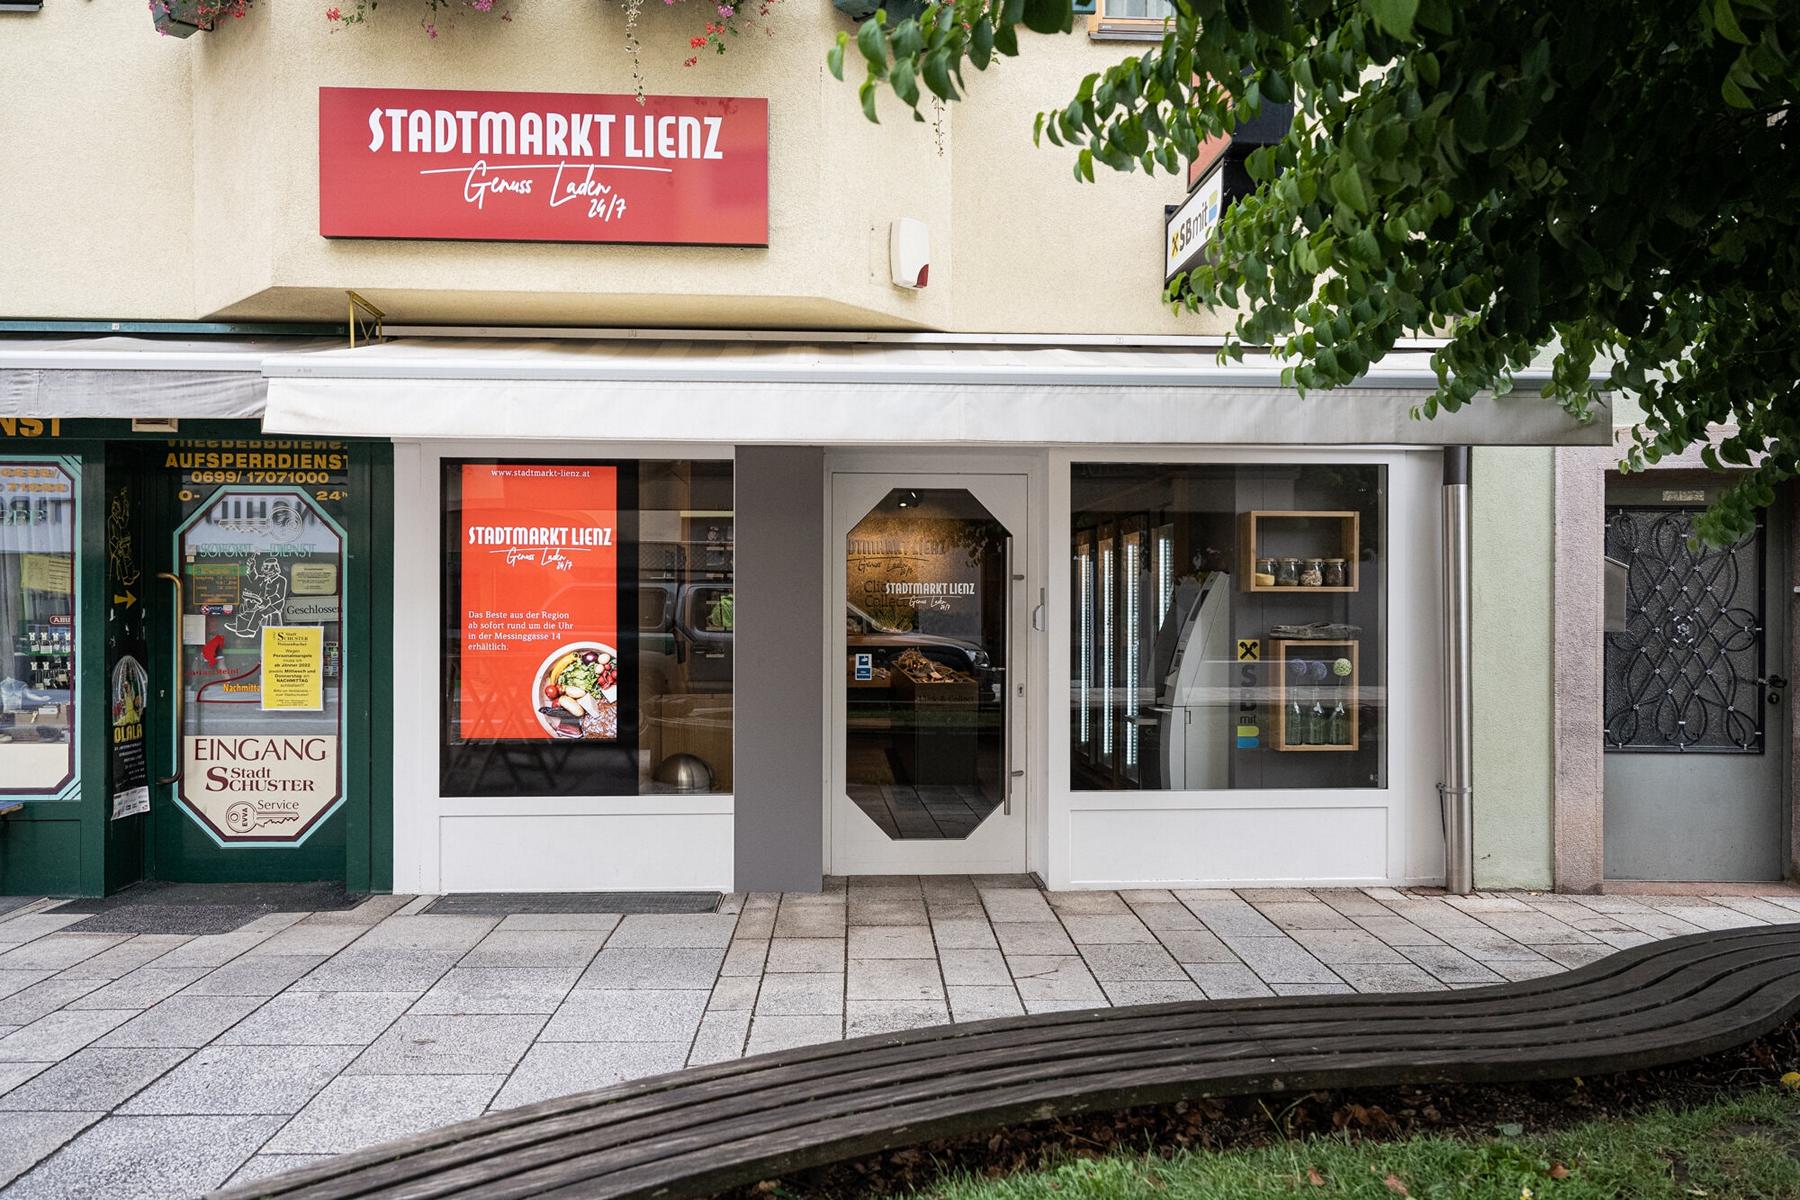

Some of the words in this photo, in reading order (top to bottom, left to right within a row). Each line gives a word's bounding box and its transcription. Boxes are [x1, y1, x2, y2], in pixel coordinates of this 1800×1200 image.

[368, 107, 616, 157] STADTMARKT
[625, 114, 723, 160] LIENZ
[464, 159, 533, 210] Genuss
[549, 160, 612, 207] Laden
[588, 198, 627, 222] 24/7
[191, 471, 241, 484] 0699/
[247, 471, 329, 484] 17071000
[491, 468, 590, 478] www.stadtmarkt-lienz.at
[468, 526, 569, 545] STADTMARKT
[571, 527, 612, 546] LIENZ
[506, 546, 535, 567] Genuss
[885, 582, 948, 594] STADTMARKT
[949, 583, 975, 595] LIENZ
[287, 604, 338, 615] Geschlosse
[468, 611, 483, 619] Das
[485, 611, 507, 619] Beste
[526, 611, 539, 619] der
[541, 611, 570, 620] Region
[468, 621, 478, 629] ab
[480, 621, 504, 629] sofort
[507, 621, 526, 629] rund
[543, 621, 556, 629] die
[478, 632, 492, 640] der
[494, 632, 549, 641] Messinggasse
[194, 738, 326, 761] EINGANG
[205, 766, 314, 792] SCHUSTER
[230, 767, 271, 779] Stadt
[257, 799, 300, 810] Service
